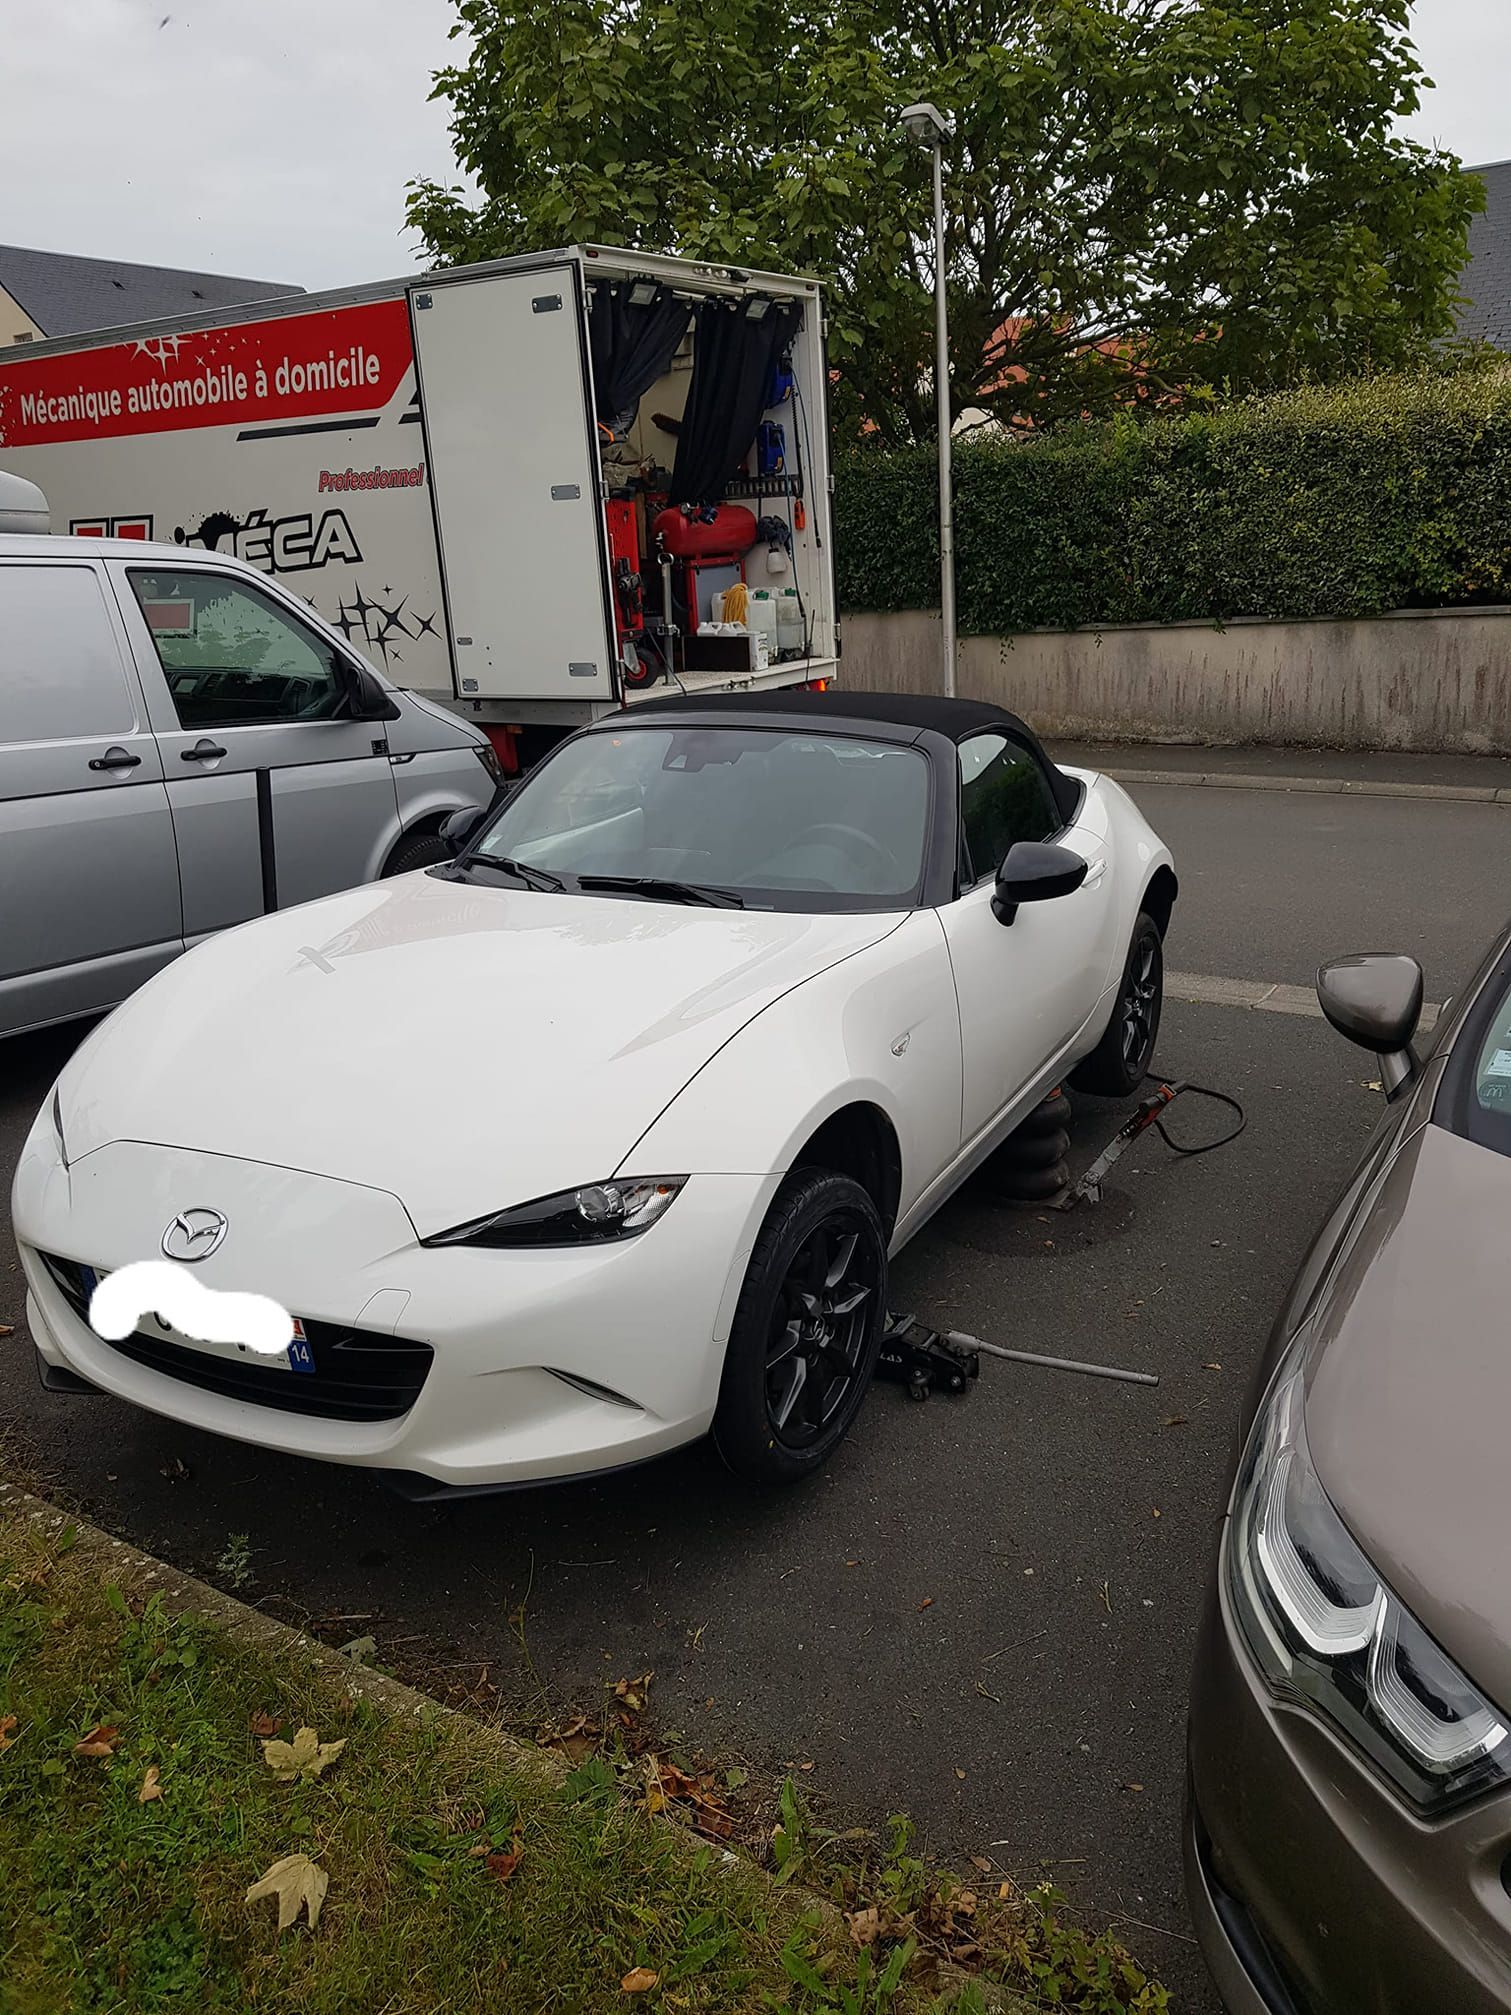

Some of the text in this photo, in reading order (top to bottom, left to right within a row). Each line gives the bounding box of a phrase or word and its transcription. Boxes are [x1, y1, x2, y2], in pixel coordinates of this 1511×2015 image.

[20, 346, 380, 426] Mécanique automobile à domicile
[319, 462, 424, 493] Professionnel
[292, 1344, 309, 1363] 14
